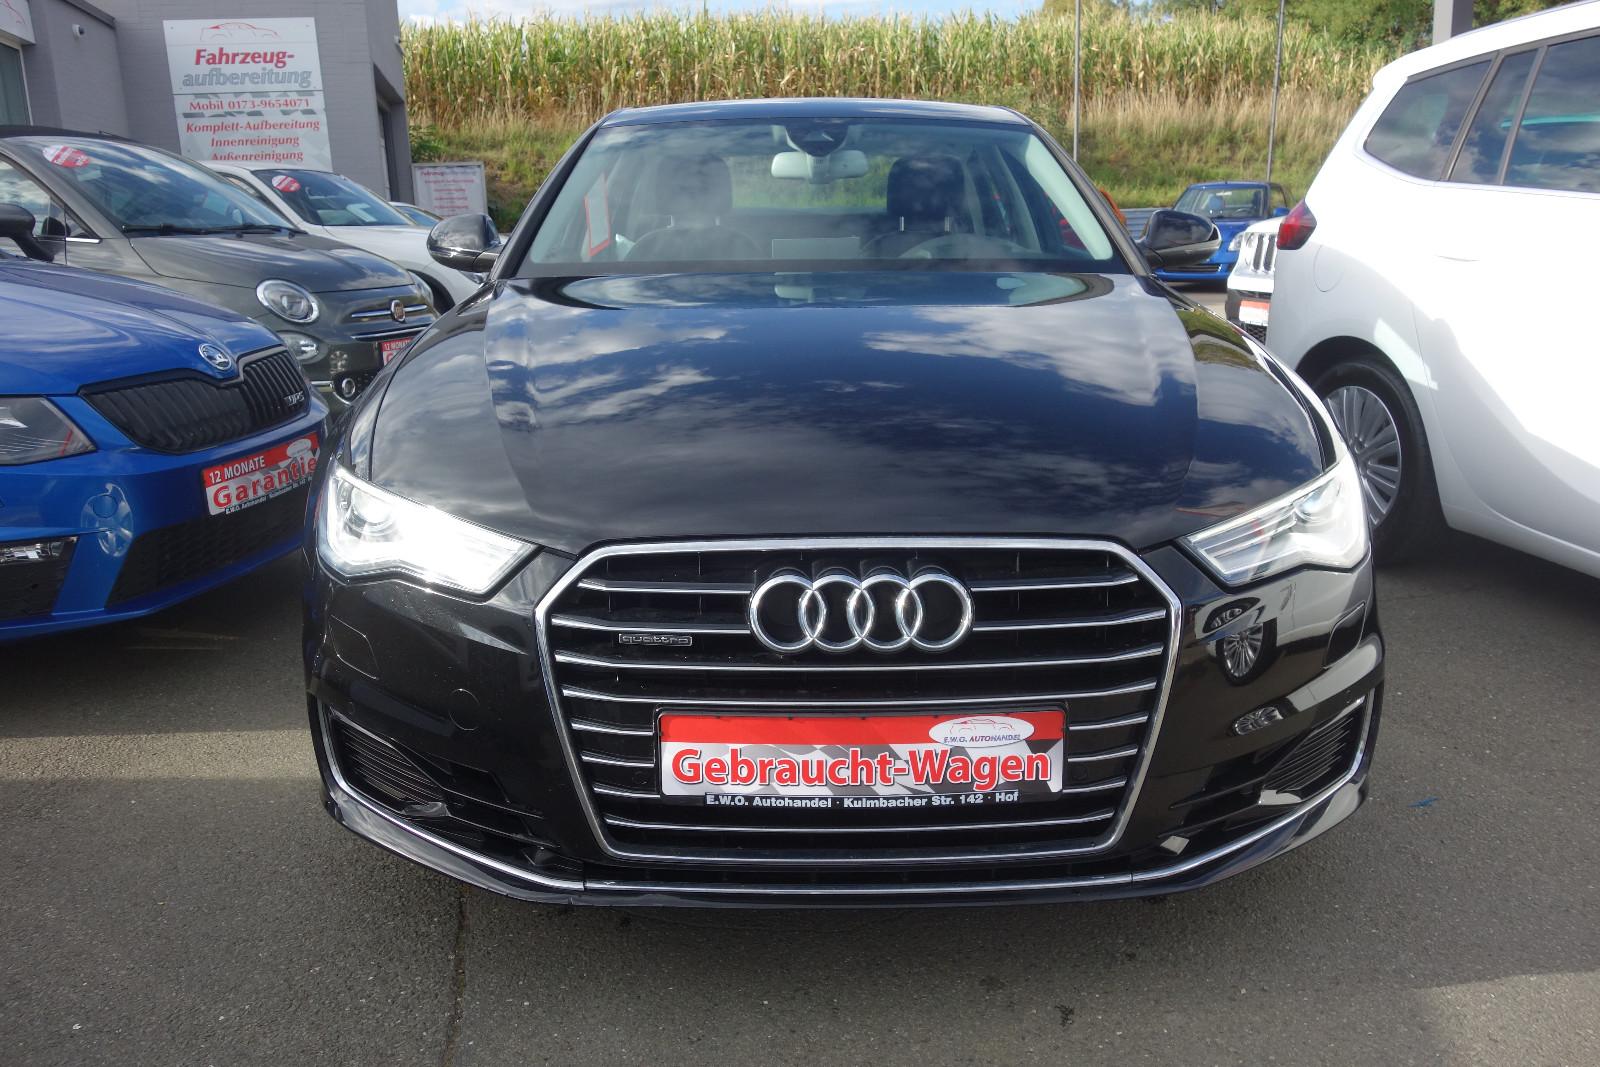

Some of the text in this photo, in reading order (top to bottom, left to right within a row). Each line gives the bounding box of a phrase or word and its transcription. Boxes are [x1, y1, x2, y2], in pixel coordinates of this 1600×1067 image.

[194, 47, 295, 69] Fahrzeug-
[182, 67, 313, 88] aufbereitung
[189, 98, 310, 111] Mobil 0173-9654071
[186, 119, 321, 134] Komplett-Aufbereitung
[211, 136, 300, 147] Innenreinigung
[212, 152, 304, 163] Außenreinigung
[209, 455, 266, 484] 12 MONATE
[213, 457, 317, 508] Garantie
[622, 635, 689, 645] quattro
[969, 734, 1021, 743] AUTOHANDEL
[671, 747, 1051, 791] Gebraucht-Wagen
[706, 791, 1019, 808] E.W.O. Autohandel Kulmbacher Str. 142 Hof
